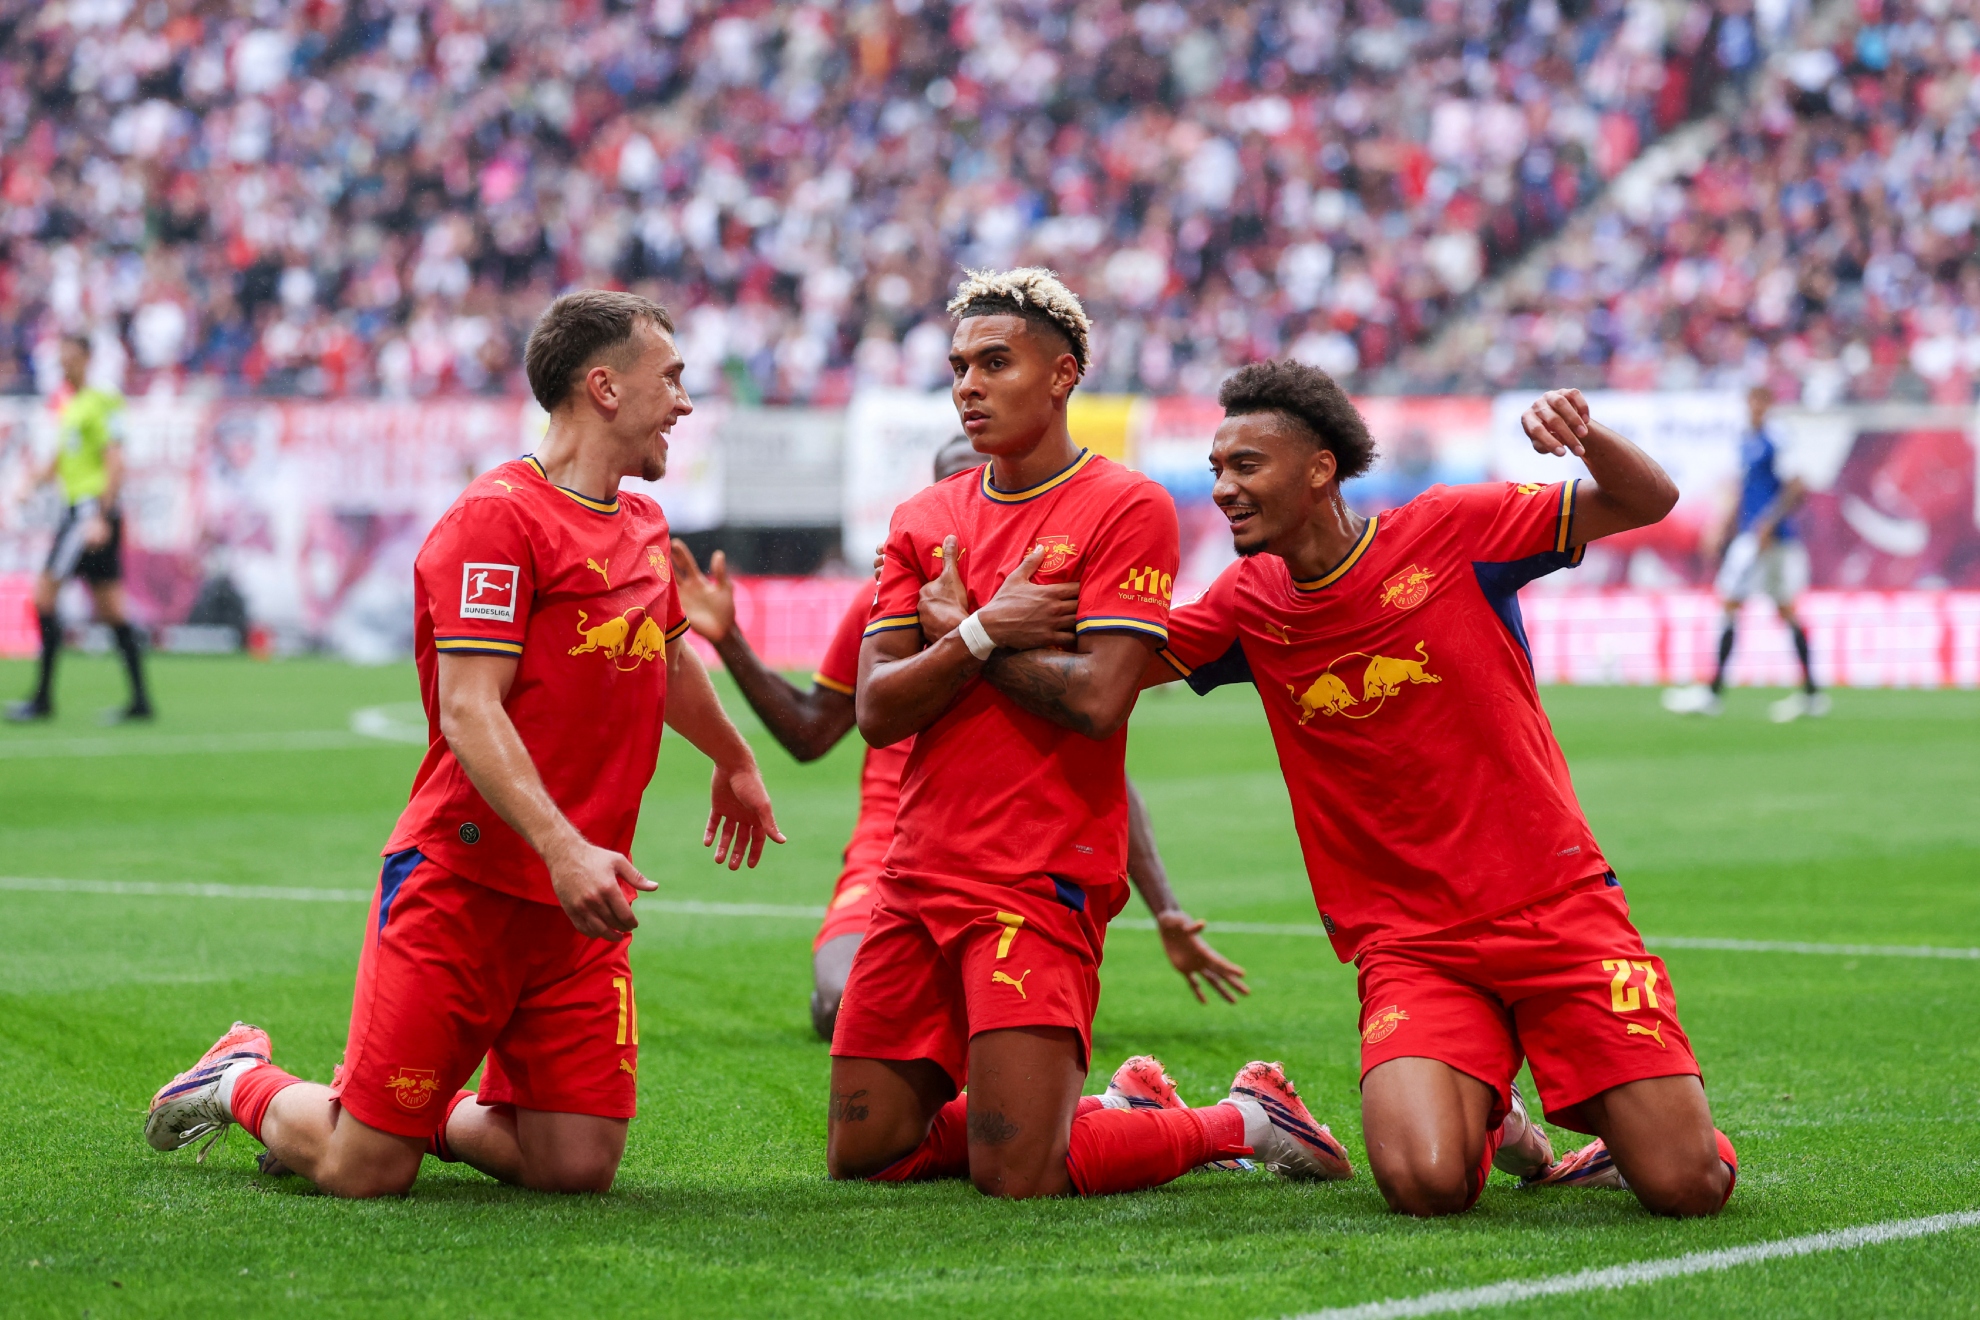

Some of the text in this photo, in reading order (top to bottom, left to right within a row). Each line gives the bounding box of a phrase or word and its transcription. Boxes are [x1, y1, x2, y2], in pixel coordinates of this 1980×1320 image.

[464, 607, 510, 617] BUNDESLIGA
[1118, 592, 1135, 600] Your
[1137, 594, 1162, 606] Trading
[995, 911, 1025, 959] 7
[1601, 958, 1660, 1013] 27
